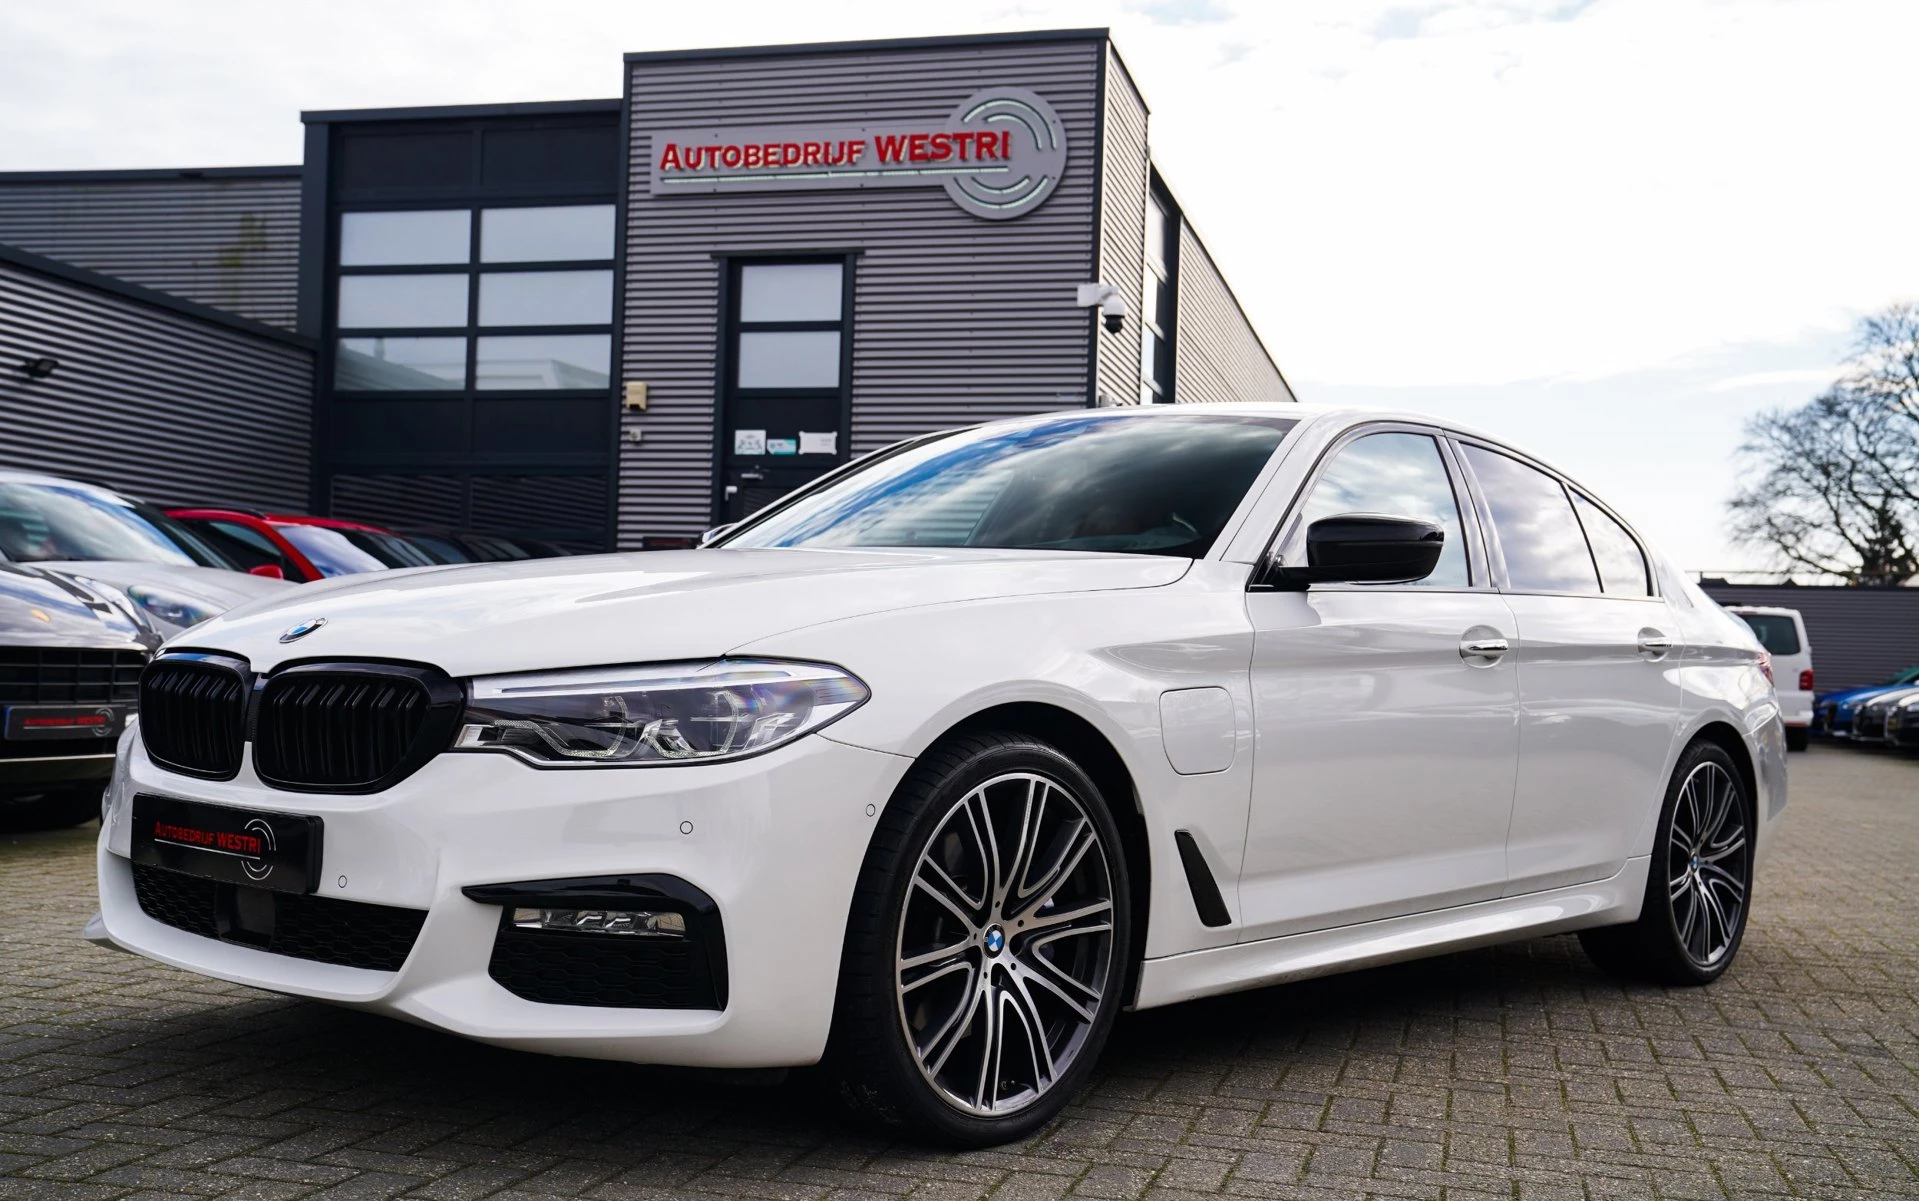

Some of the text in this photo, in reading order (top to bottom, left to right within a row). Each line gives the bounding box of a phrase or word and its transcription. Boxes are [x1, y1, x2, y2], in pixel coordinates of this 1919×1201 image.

[660, 131, 1011, 171] AUTOBEDRIJF WESTRI
[155, 822, 261, 853] AUTOBEDRIJF WESTRI
